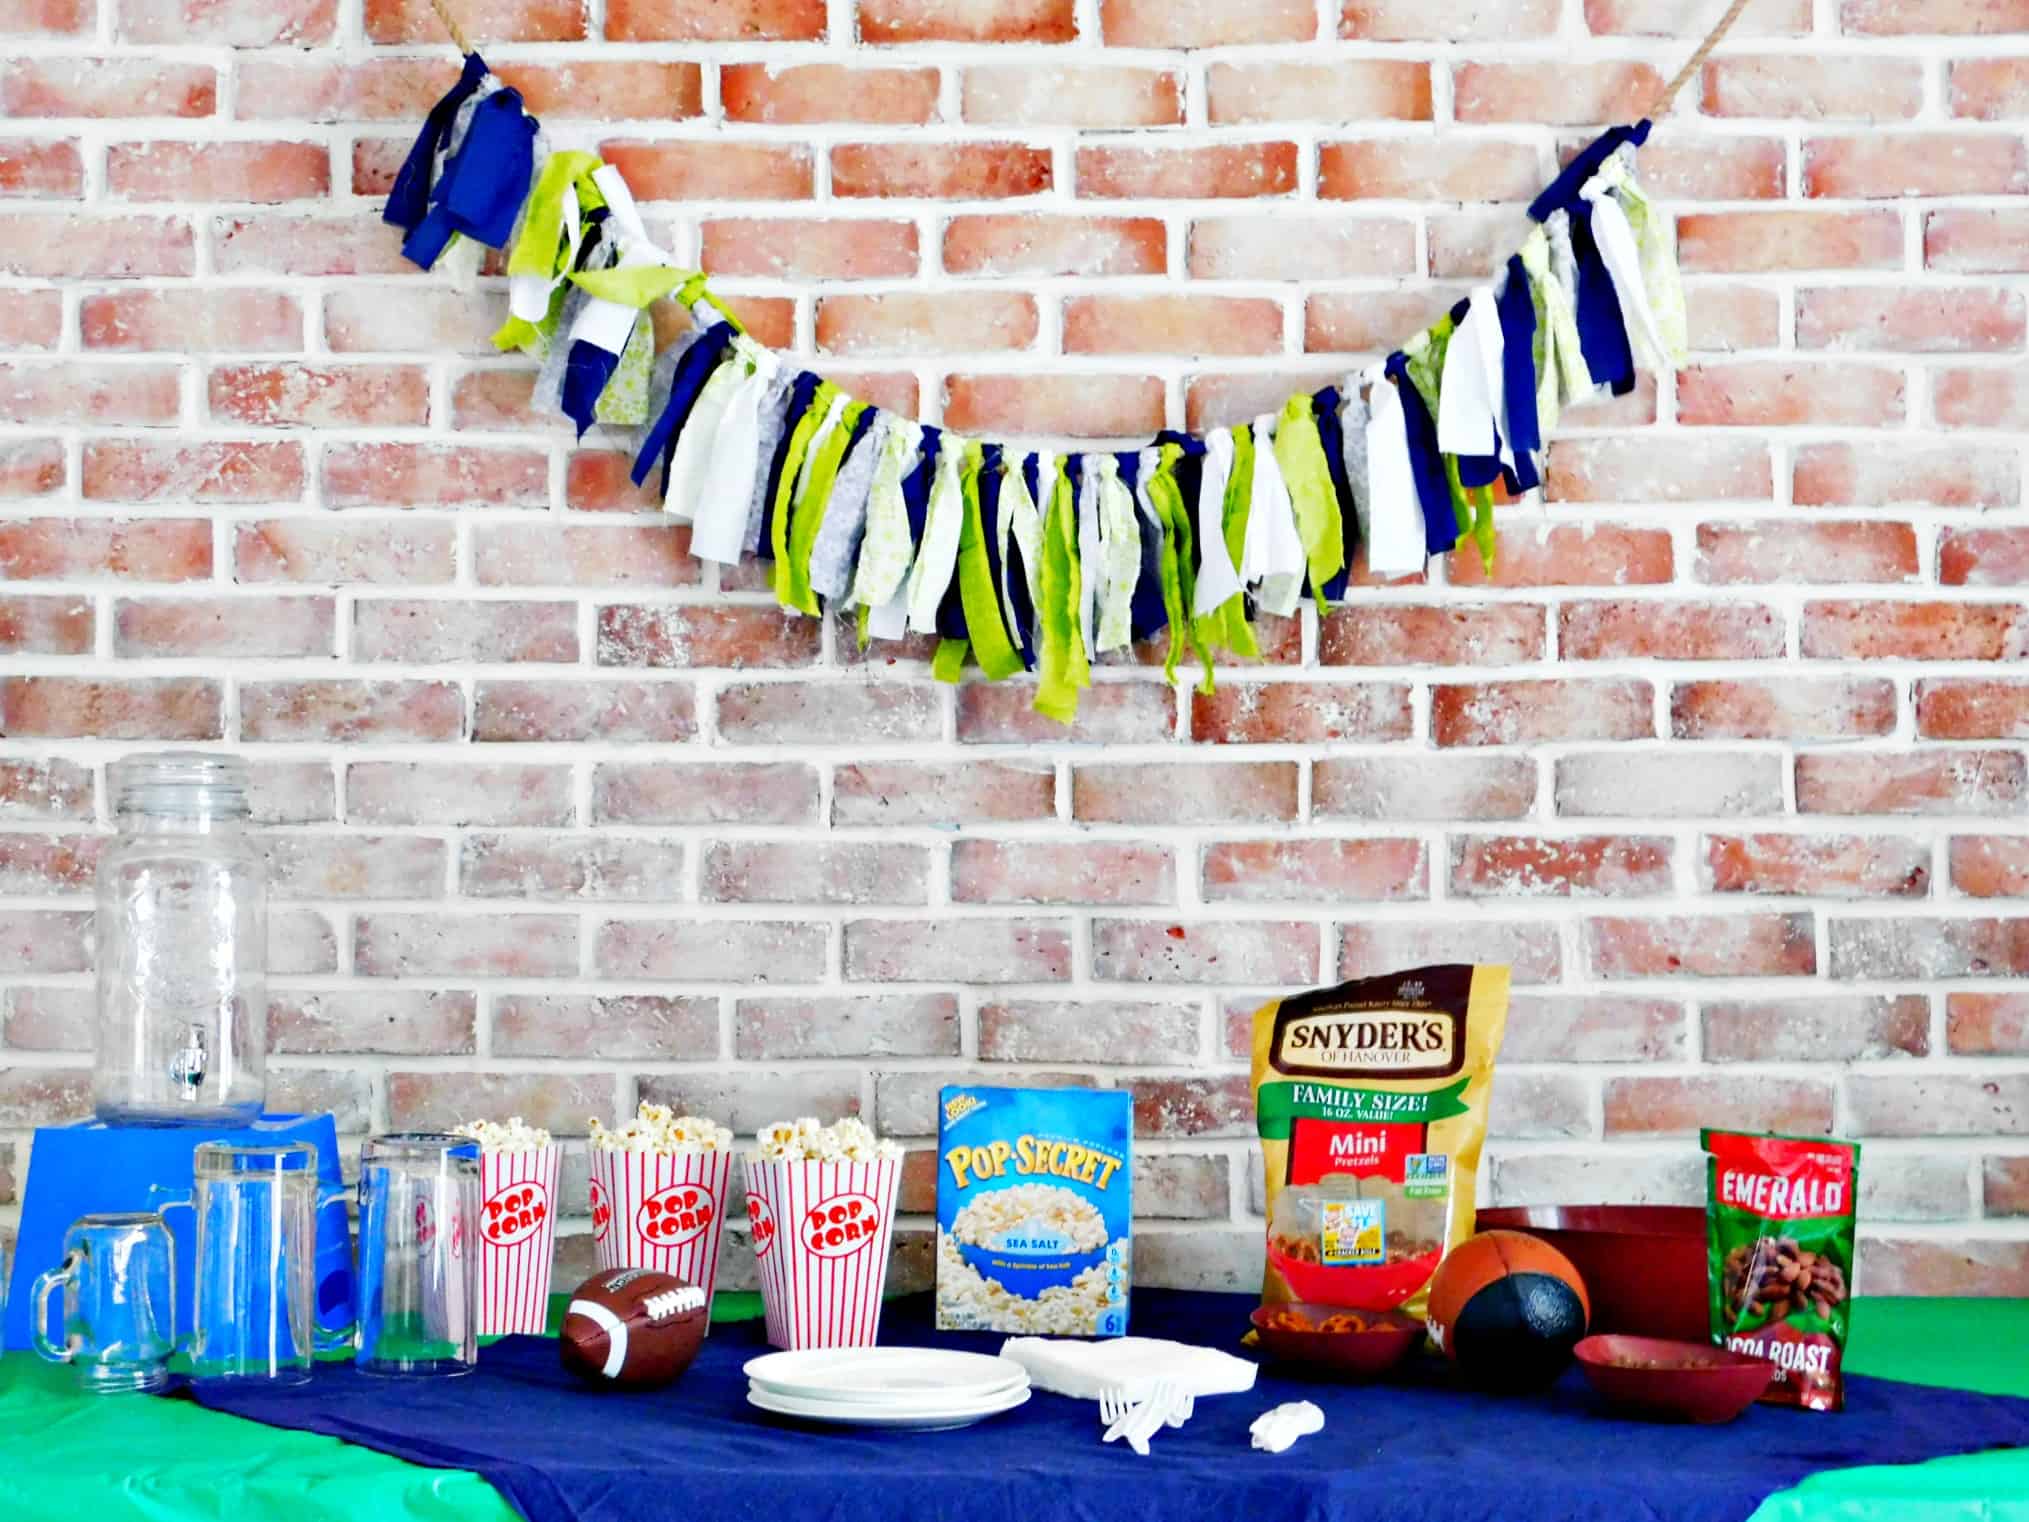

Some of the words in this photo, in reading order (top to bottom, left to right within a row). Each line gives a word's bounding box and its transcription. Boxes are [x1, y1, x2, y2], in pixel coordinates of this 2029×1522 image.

[1291, 1019, 1444, 1053] SNYDER'S
[1320, 1052, 1337, 1063] OF
[1343, 1051, 1411, 1064] HANOVER
[1292, 1083, 1366, 1109] FAMILY
[1371, 1094, 1429, 1112] SIZE!
[1322, 1106, 1333, 1118] 16
[1328, 1129, 1388, 1157] Mini
[1333, 1154, 1381, 1168] Pretzels
[486, 1187, 534, 1220] POP
[646, 1190, 699, 1220] POP
[1722, 1170, 1842, 1216] EMERALD
[487, 1200, 546, 1239] CORN
[645, 1204, 713, 1239] CORN
[811, 1200, 863, 1231] POP
[810, 1214, 878, 1250] CORN
[1006, 1238, 1028, 1249] SEA
[1032, 1239, 1059, 1249] SALT
[1768, 1340, 1832, 1374] ROAST
